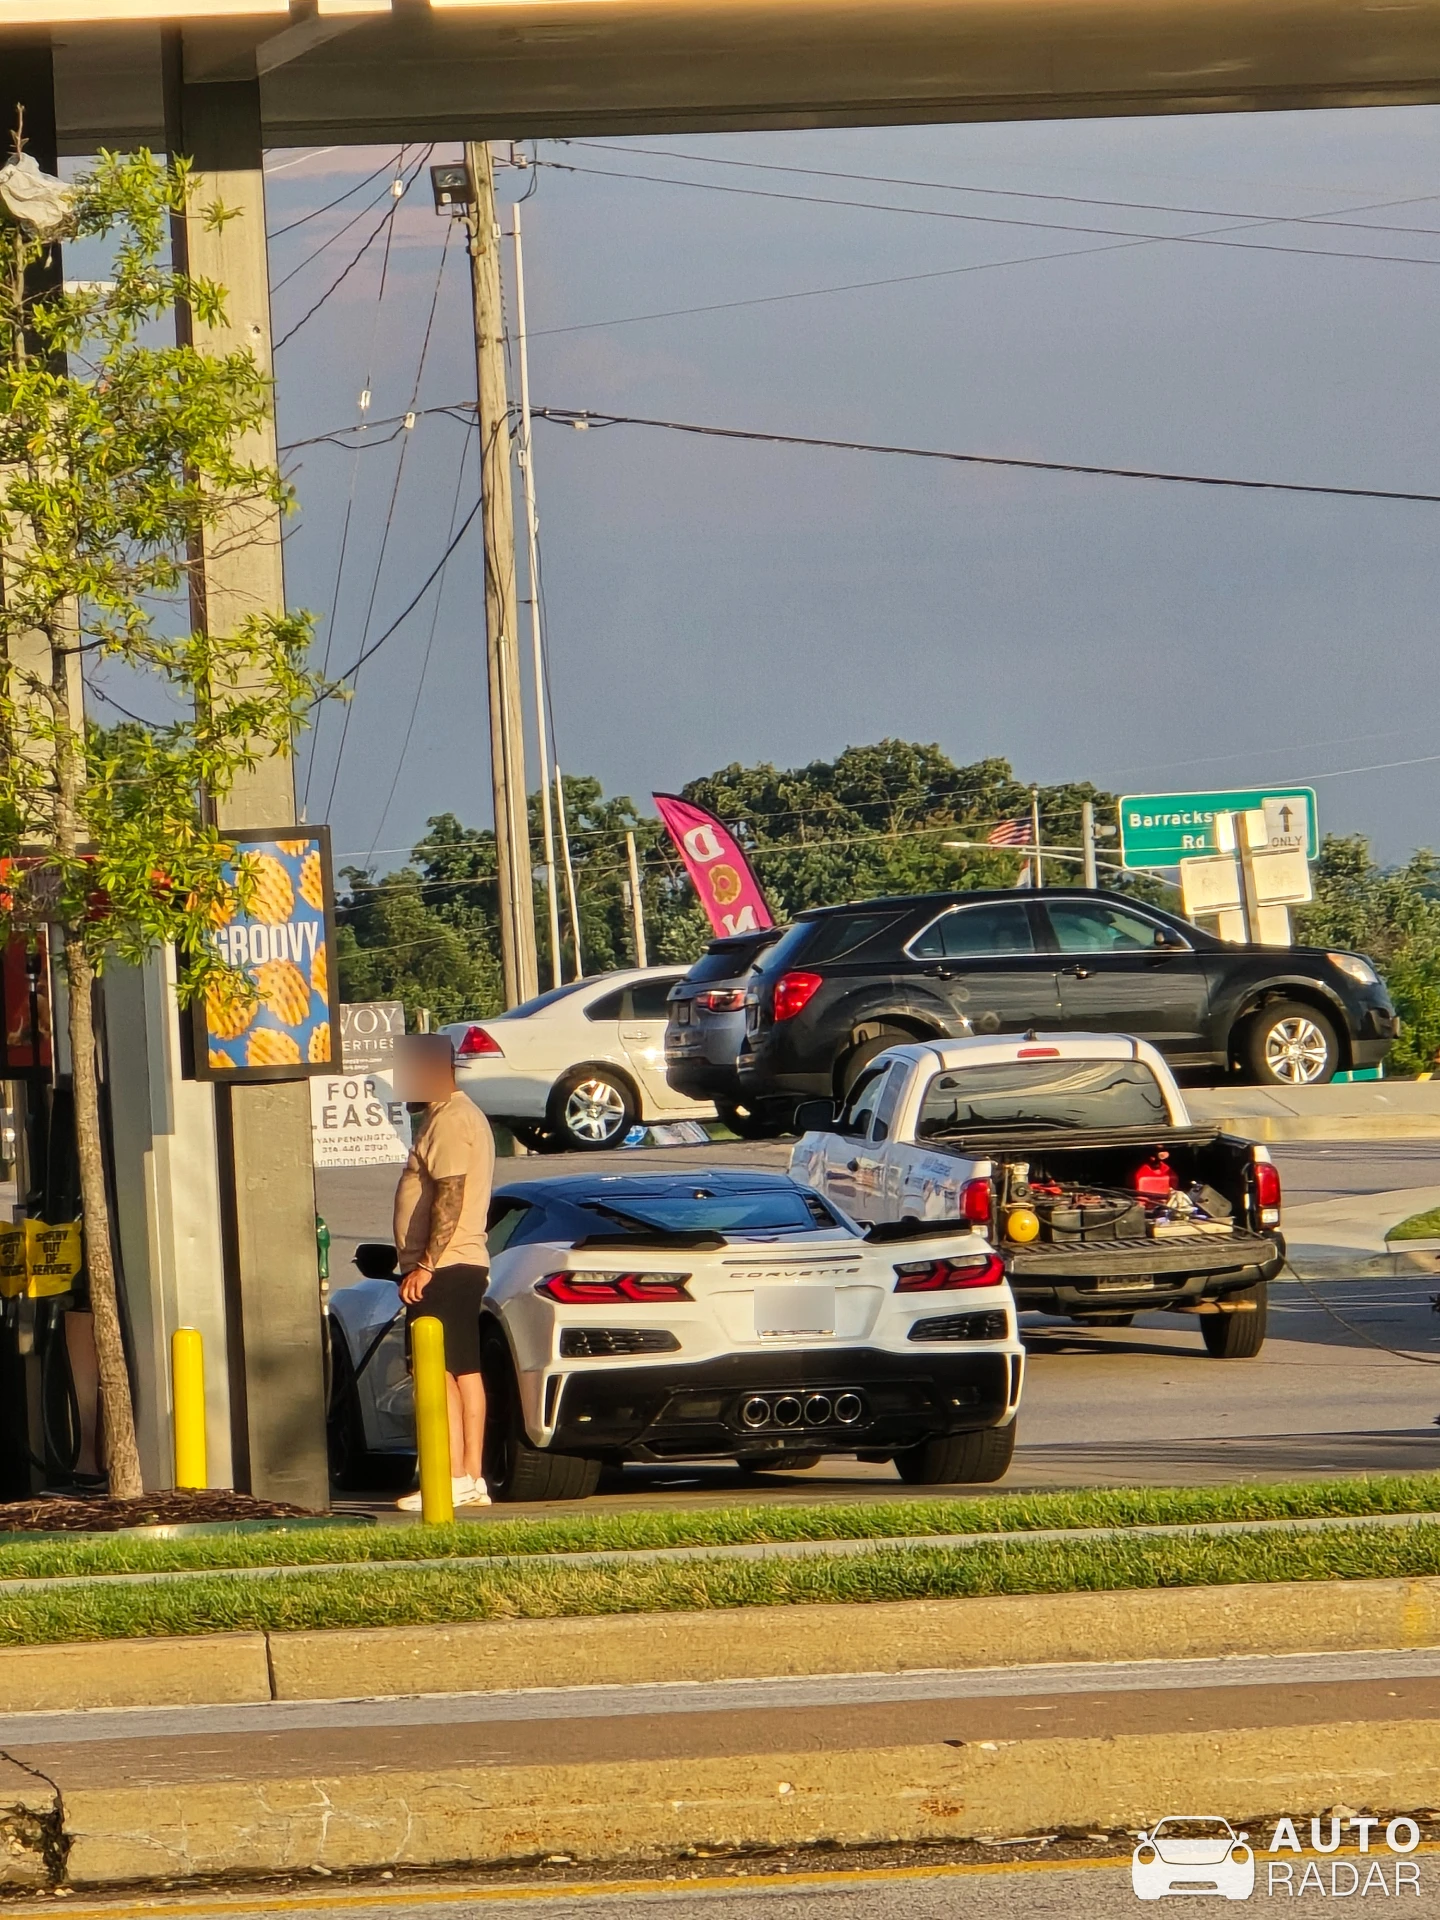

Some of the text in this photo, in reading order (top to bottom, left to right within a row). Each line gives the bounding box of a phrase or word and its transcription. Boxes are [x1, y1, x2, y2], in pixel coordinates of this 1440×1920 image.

[1129, 810, 1215, 828] Barracks
[1181, 835, 1205, 849] Rd
[1271, 835, 1303, 848] ONLY
[212, 921, 318, 965] GROOVY
[340, 1008, 397, 1035] VOY
[327, 1080, 376, 1101] FOR
[312, 1101, 404, 1130] EASE
[43, 1242, 61, 1253] OUT
[729, 1267, 861, 1279] CORVETTE
